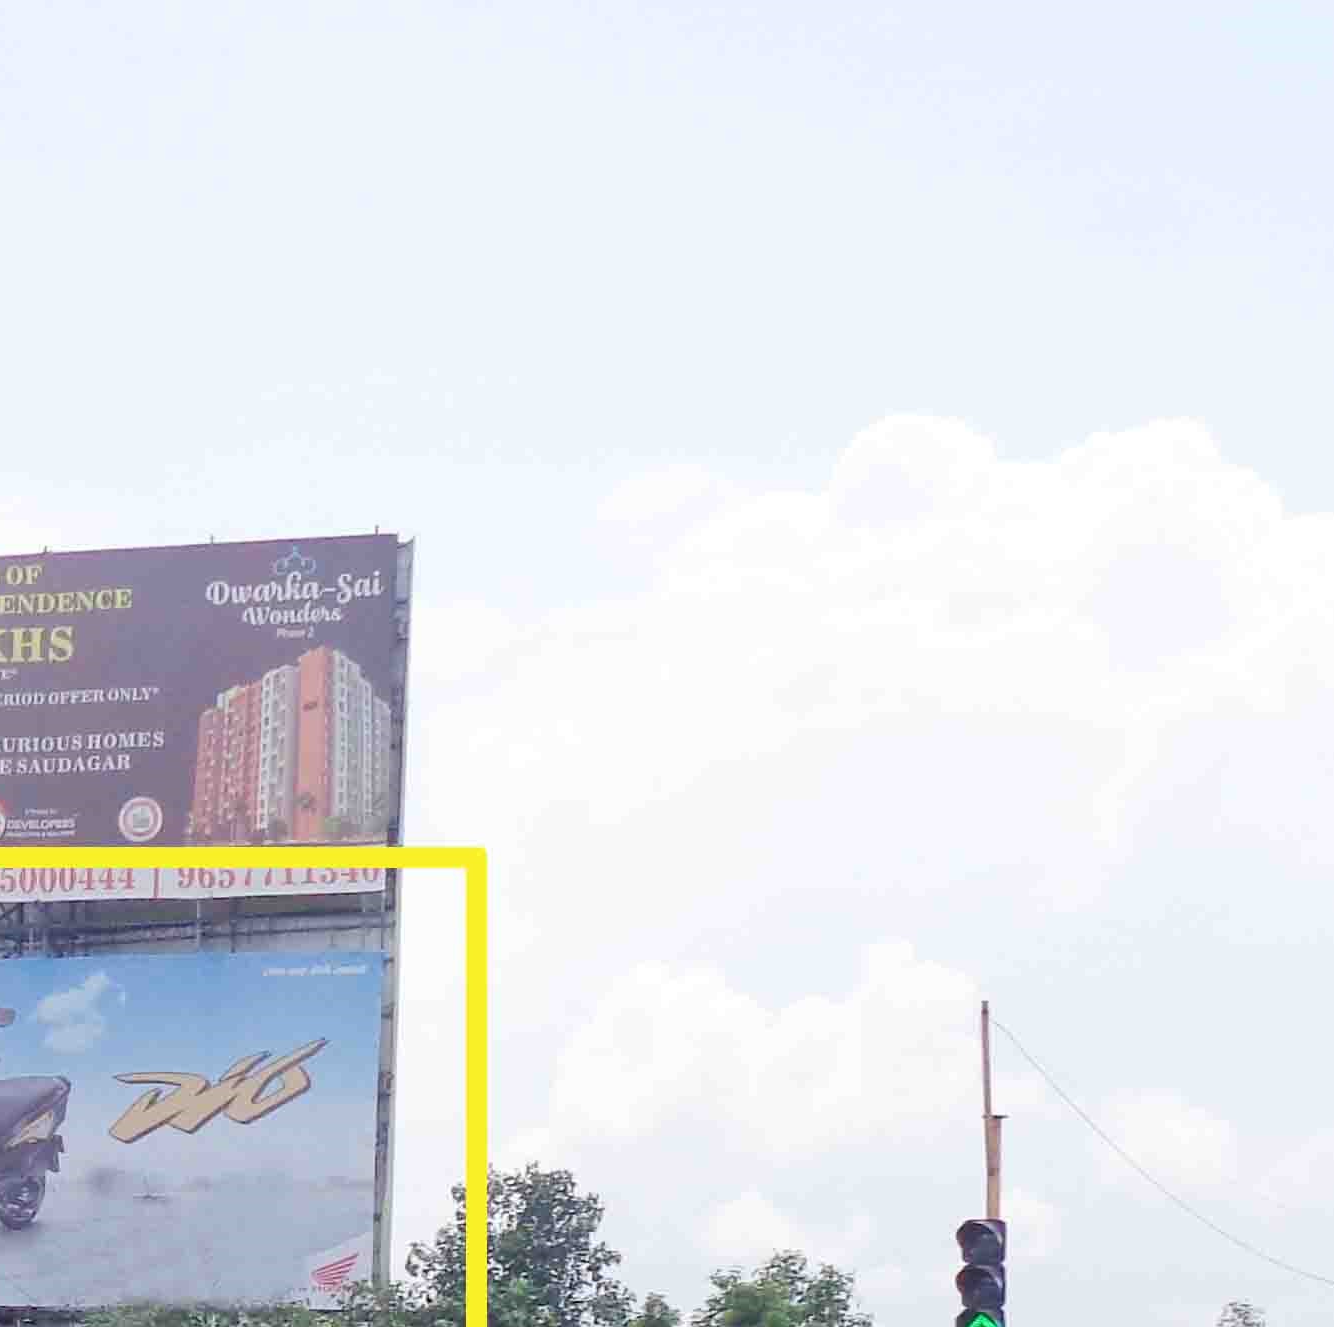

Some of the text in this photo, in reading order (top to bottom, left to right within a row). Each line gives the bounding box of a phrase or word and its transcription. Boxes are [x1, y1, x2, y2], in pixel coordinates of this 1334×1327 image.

[6, 565, 44, 586] OF
[205, 570, 384, 605] Dwarka-Sai
[242, 600, 343, 626] Wonders
[48, 689, 105, 705] OFFER
[85, 731, 165, 750] HOMES
[13, 754, 131, 775] SAUDAGAR
